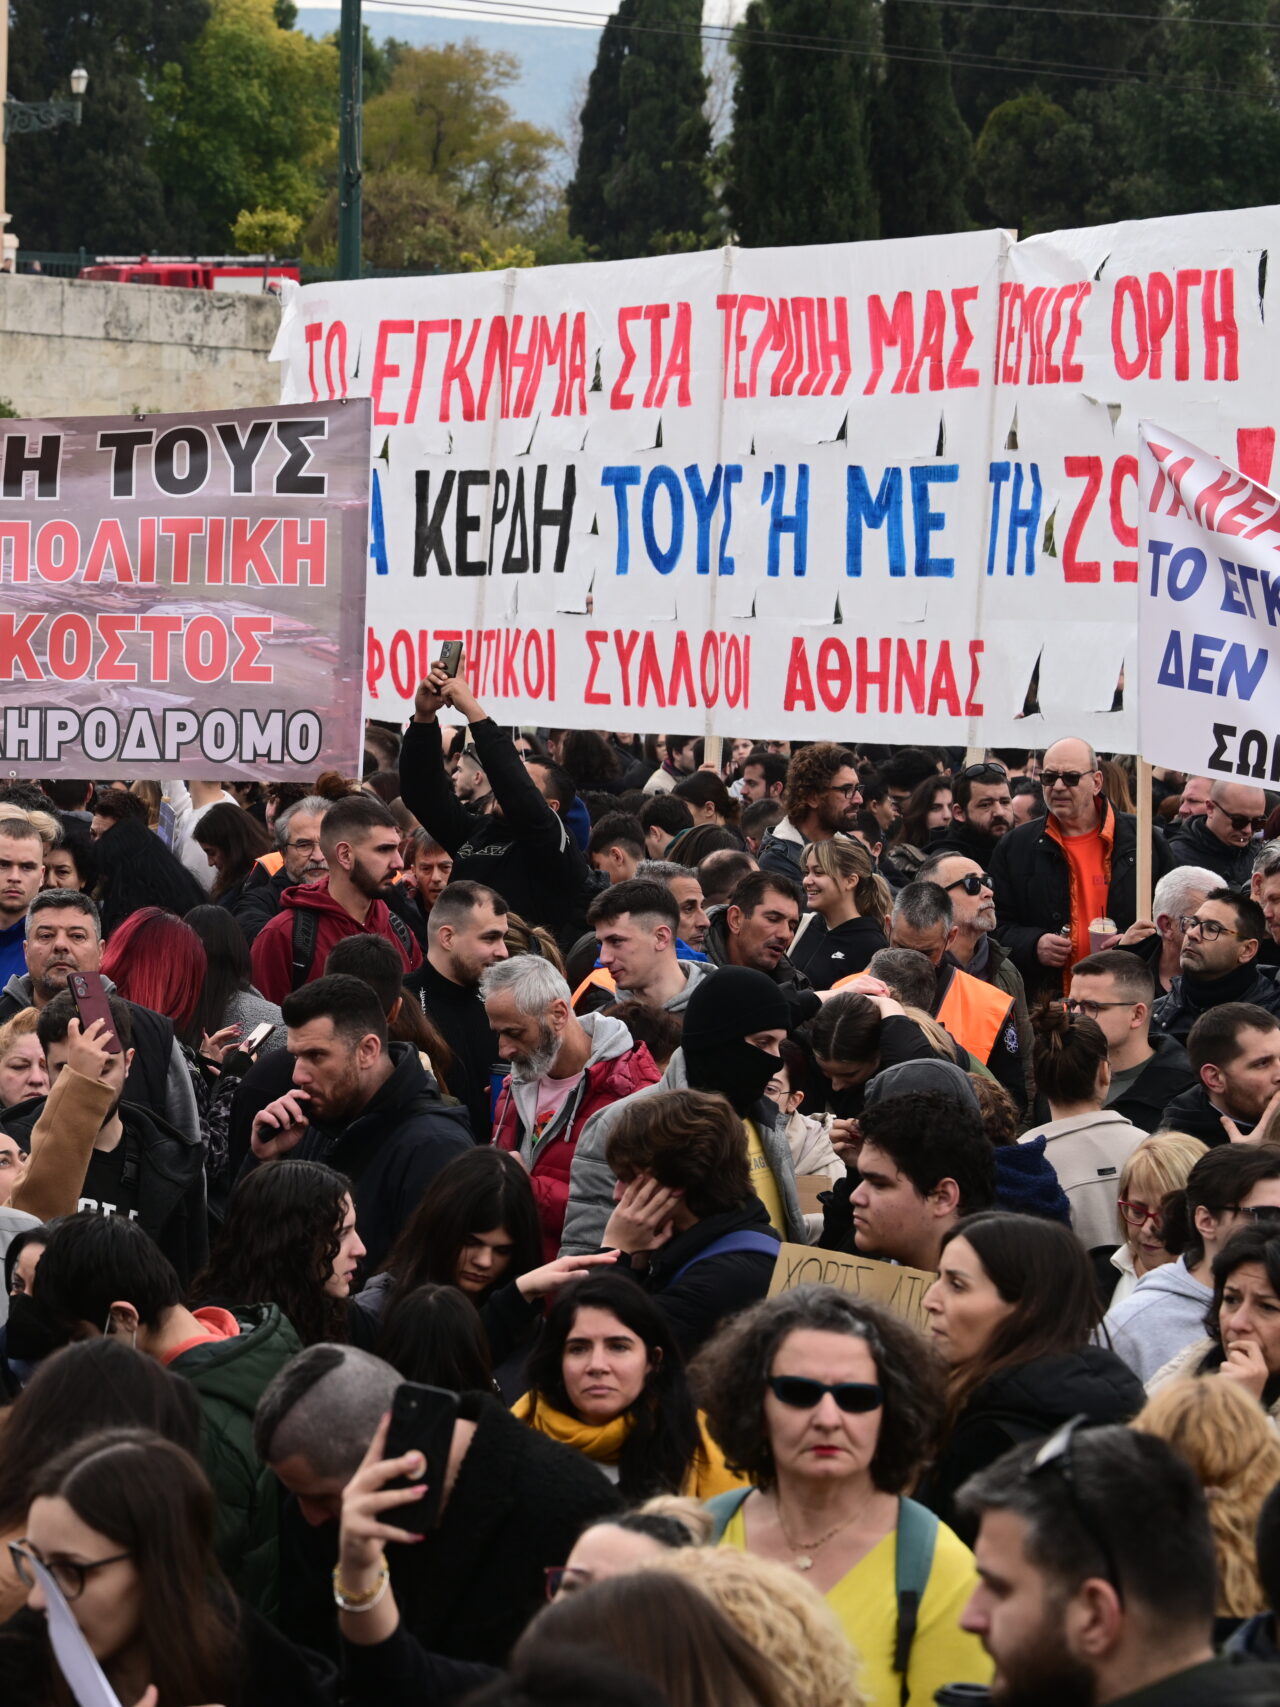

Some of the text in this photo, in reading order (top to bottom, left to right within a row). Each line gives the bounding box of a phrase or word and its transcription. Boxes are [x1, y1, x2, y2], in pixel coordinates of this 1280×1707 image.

[373, 312, 587, 426] ΕΓΚΛΗΜΑ
[610, 302, 691, 410] ΣΤΑ
[716, 293, 850, 399] ΤΕΜΠΗ
[862, 286, 980, 395] ΜΑΣ
[1111, 268, 1239, 381] ΟΡΓΗ
[97, 418, 328, 500] ΤΟΥΣ
[413, 464, 576, 577] ΚΕΡΔΗ
[600, 463, 743, 577] ΤΟΥΣ
[846, 464, 959, 578] ΜΕ
[987, 461, 1043, 577] ΤΗ
[1148, 539, 1207, 602] ΤΟ
[584, 630, 751, 711] ΣΥΛΛΟΓΟΙ
[783, 636, 985, 717] ΑΘΗΝΑΣ
[1157, 629, 1269, 702] ΔΕΝ
